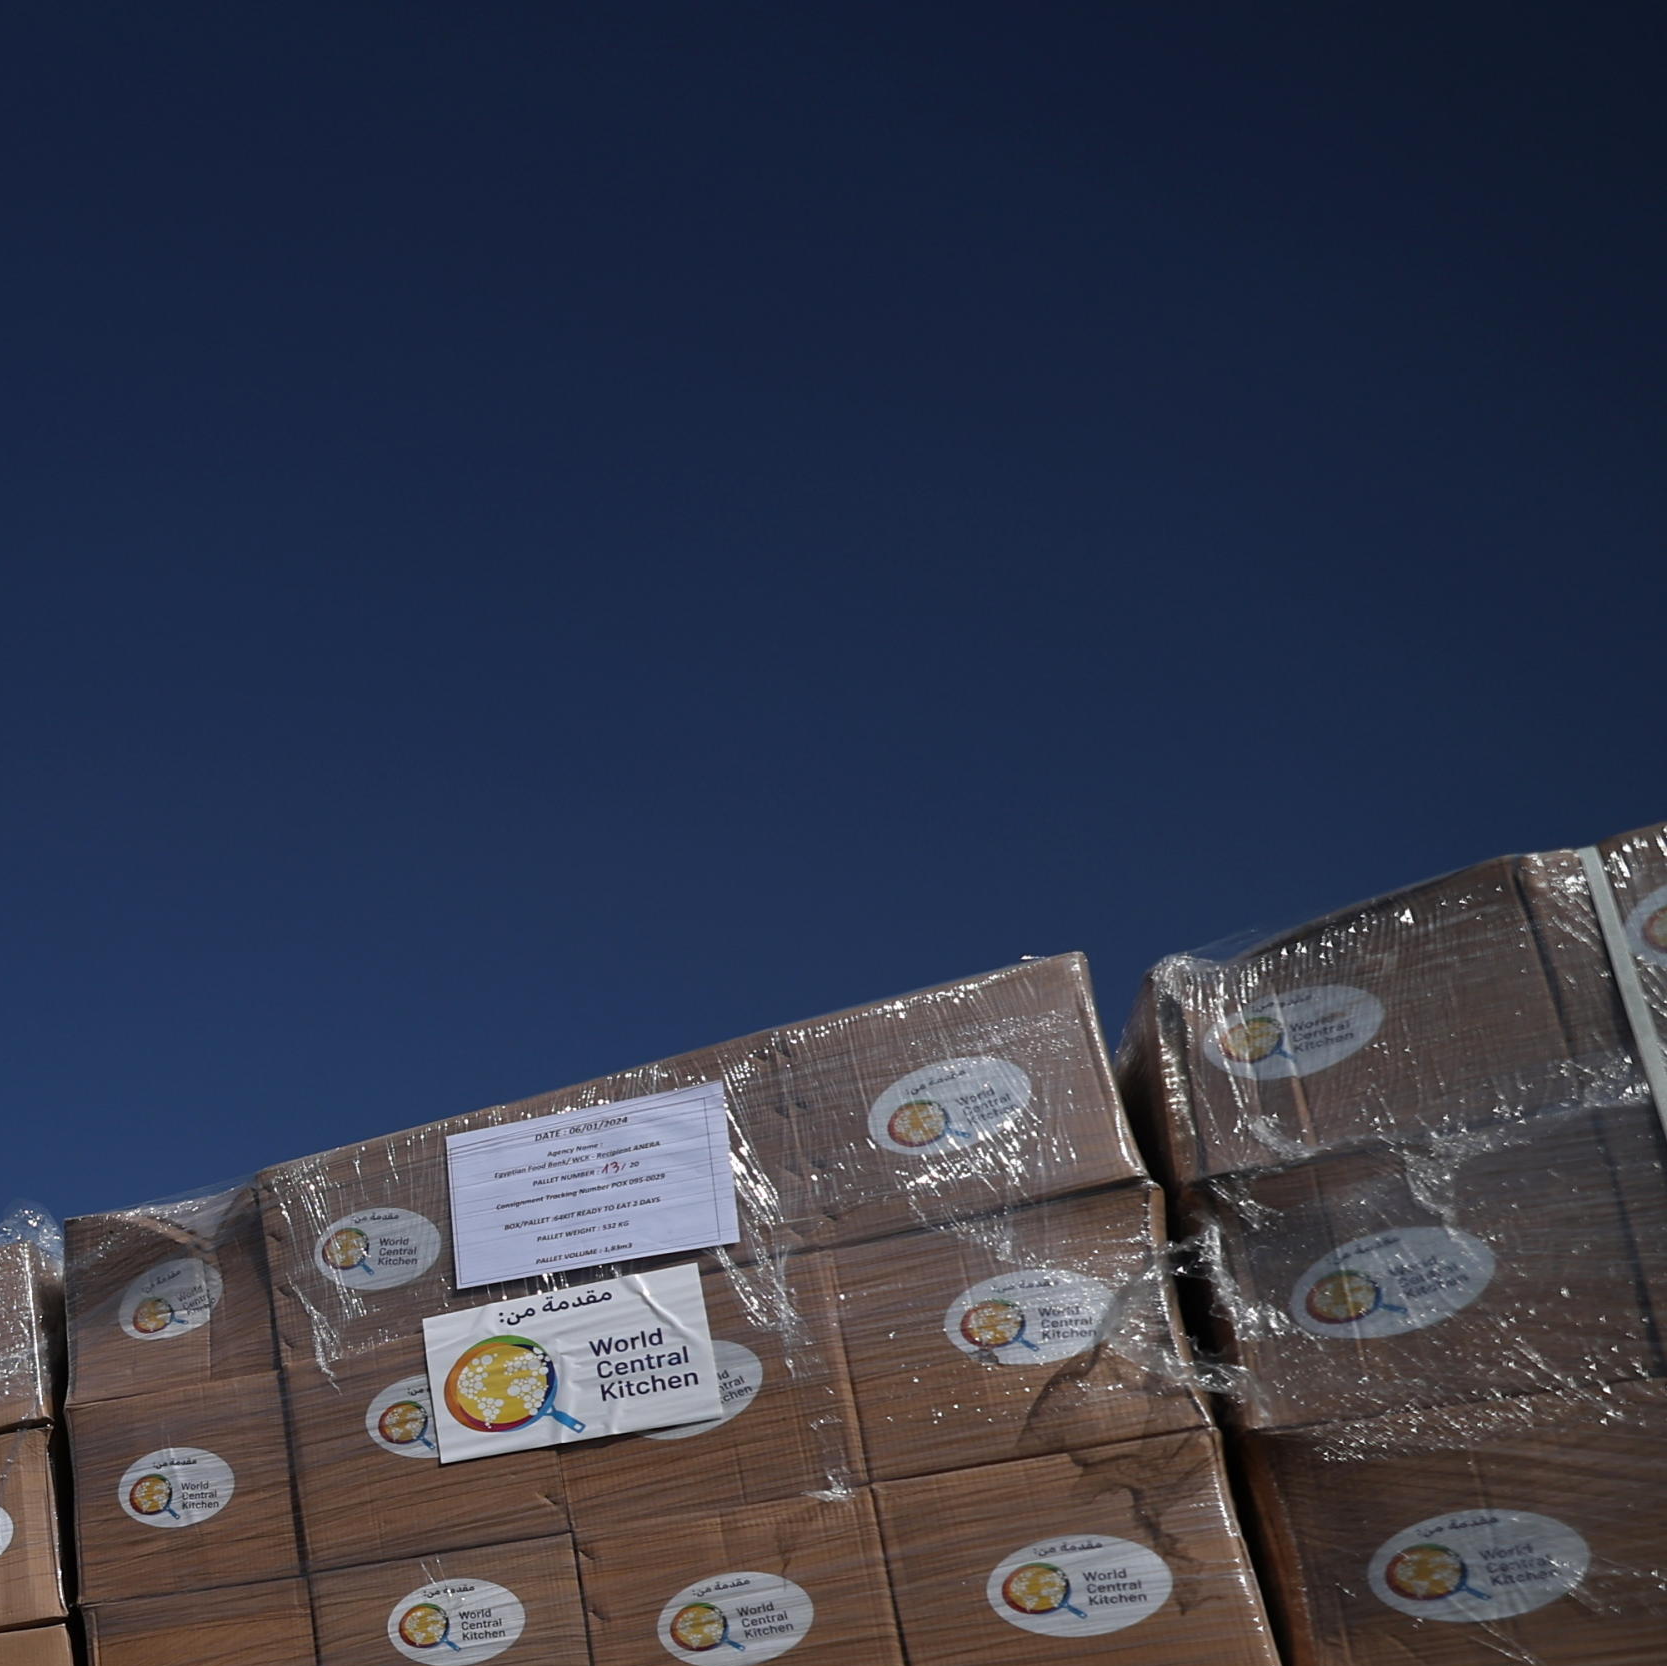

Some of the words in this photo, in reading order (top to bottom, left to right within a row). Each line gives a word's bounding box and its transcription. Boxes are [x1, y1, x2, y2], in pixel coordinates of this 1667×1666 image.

[535, 1130, 561, 1142] DATE
[569, 1116, 628, 1135] 06/01/2024
[547, 1147, 575, 1158] Agency
[576, 1143, 597, 1153] Name
[494, 1167, 526, 1179] Egyptian
[528, 1163, 546, 1173] Food
[596, 1145, 632, 1162] Recipient
[633, 1141, 661, 1153] ANERA
[532, 1176, 559, 1186] PALLET
[561, 1169, 595, 1181] NUMBER
[496, 1196, 544, 1210] Consignment
[546, 1189, 577, 1201] Tracking
[579, 1183, 610, 1195] Number
[504, 1217, 550, 1231] BOX/PALLET
[577, 1207, 603, 1218] READY
[604, 1203, 615, 1212] TO
[617, 1200, 632, 1211] EAT
[640, 1196, 661, 1206] DAYS
[537, 1232, 563, 1242] PALLET
[565, 1226, 596, 1238] WEIGHT
[618, 1220, 630, 1229] KG
[379, 1236, 410, 1247] World
[378, 1246, 418, 1257] Central
[536, 1254, 562, 1264] PALLET
[564, 1248, 598, 1260] VOLUME
[378, 1256, 418, 1266] Kitchen
[542, 1289, 613, 1313] مقدمة
[588, 1328, 664, 1357] World
[596, 1345, 690, 1379] Central
[600, 1371, 699, 1401] Kitchen
[719, 1376, 746, 1392] ntral
[181, 1482, 209, 1490] World
[181, 1490, 218, 1500] Central
[182, 1500, 219, 1510] Kitchen
[1082, 1568, 1127, 1582] World
[1086, 1580, 1143, 1594] Central
[1088, 1591, 1147, 1606] Kitchen
[458, 1608, 492, 1620] World
[736, 1602, 775, 1618] World
[460, 1619, 503, 1631] Central
[741, 1610, 788, 1628] Central
[462, 1629, 506, 1641] Kitchen
[743, 1621, 794, 1639] Kitchen
